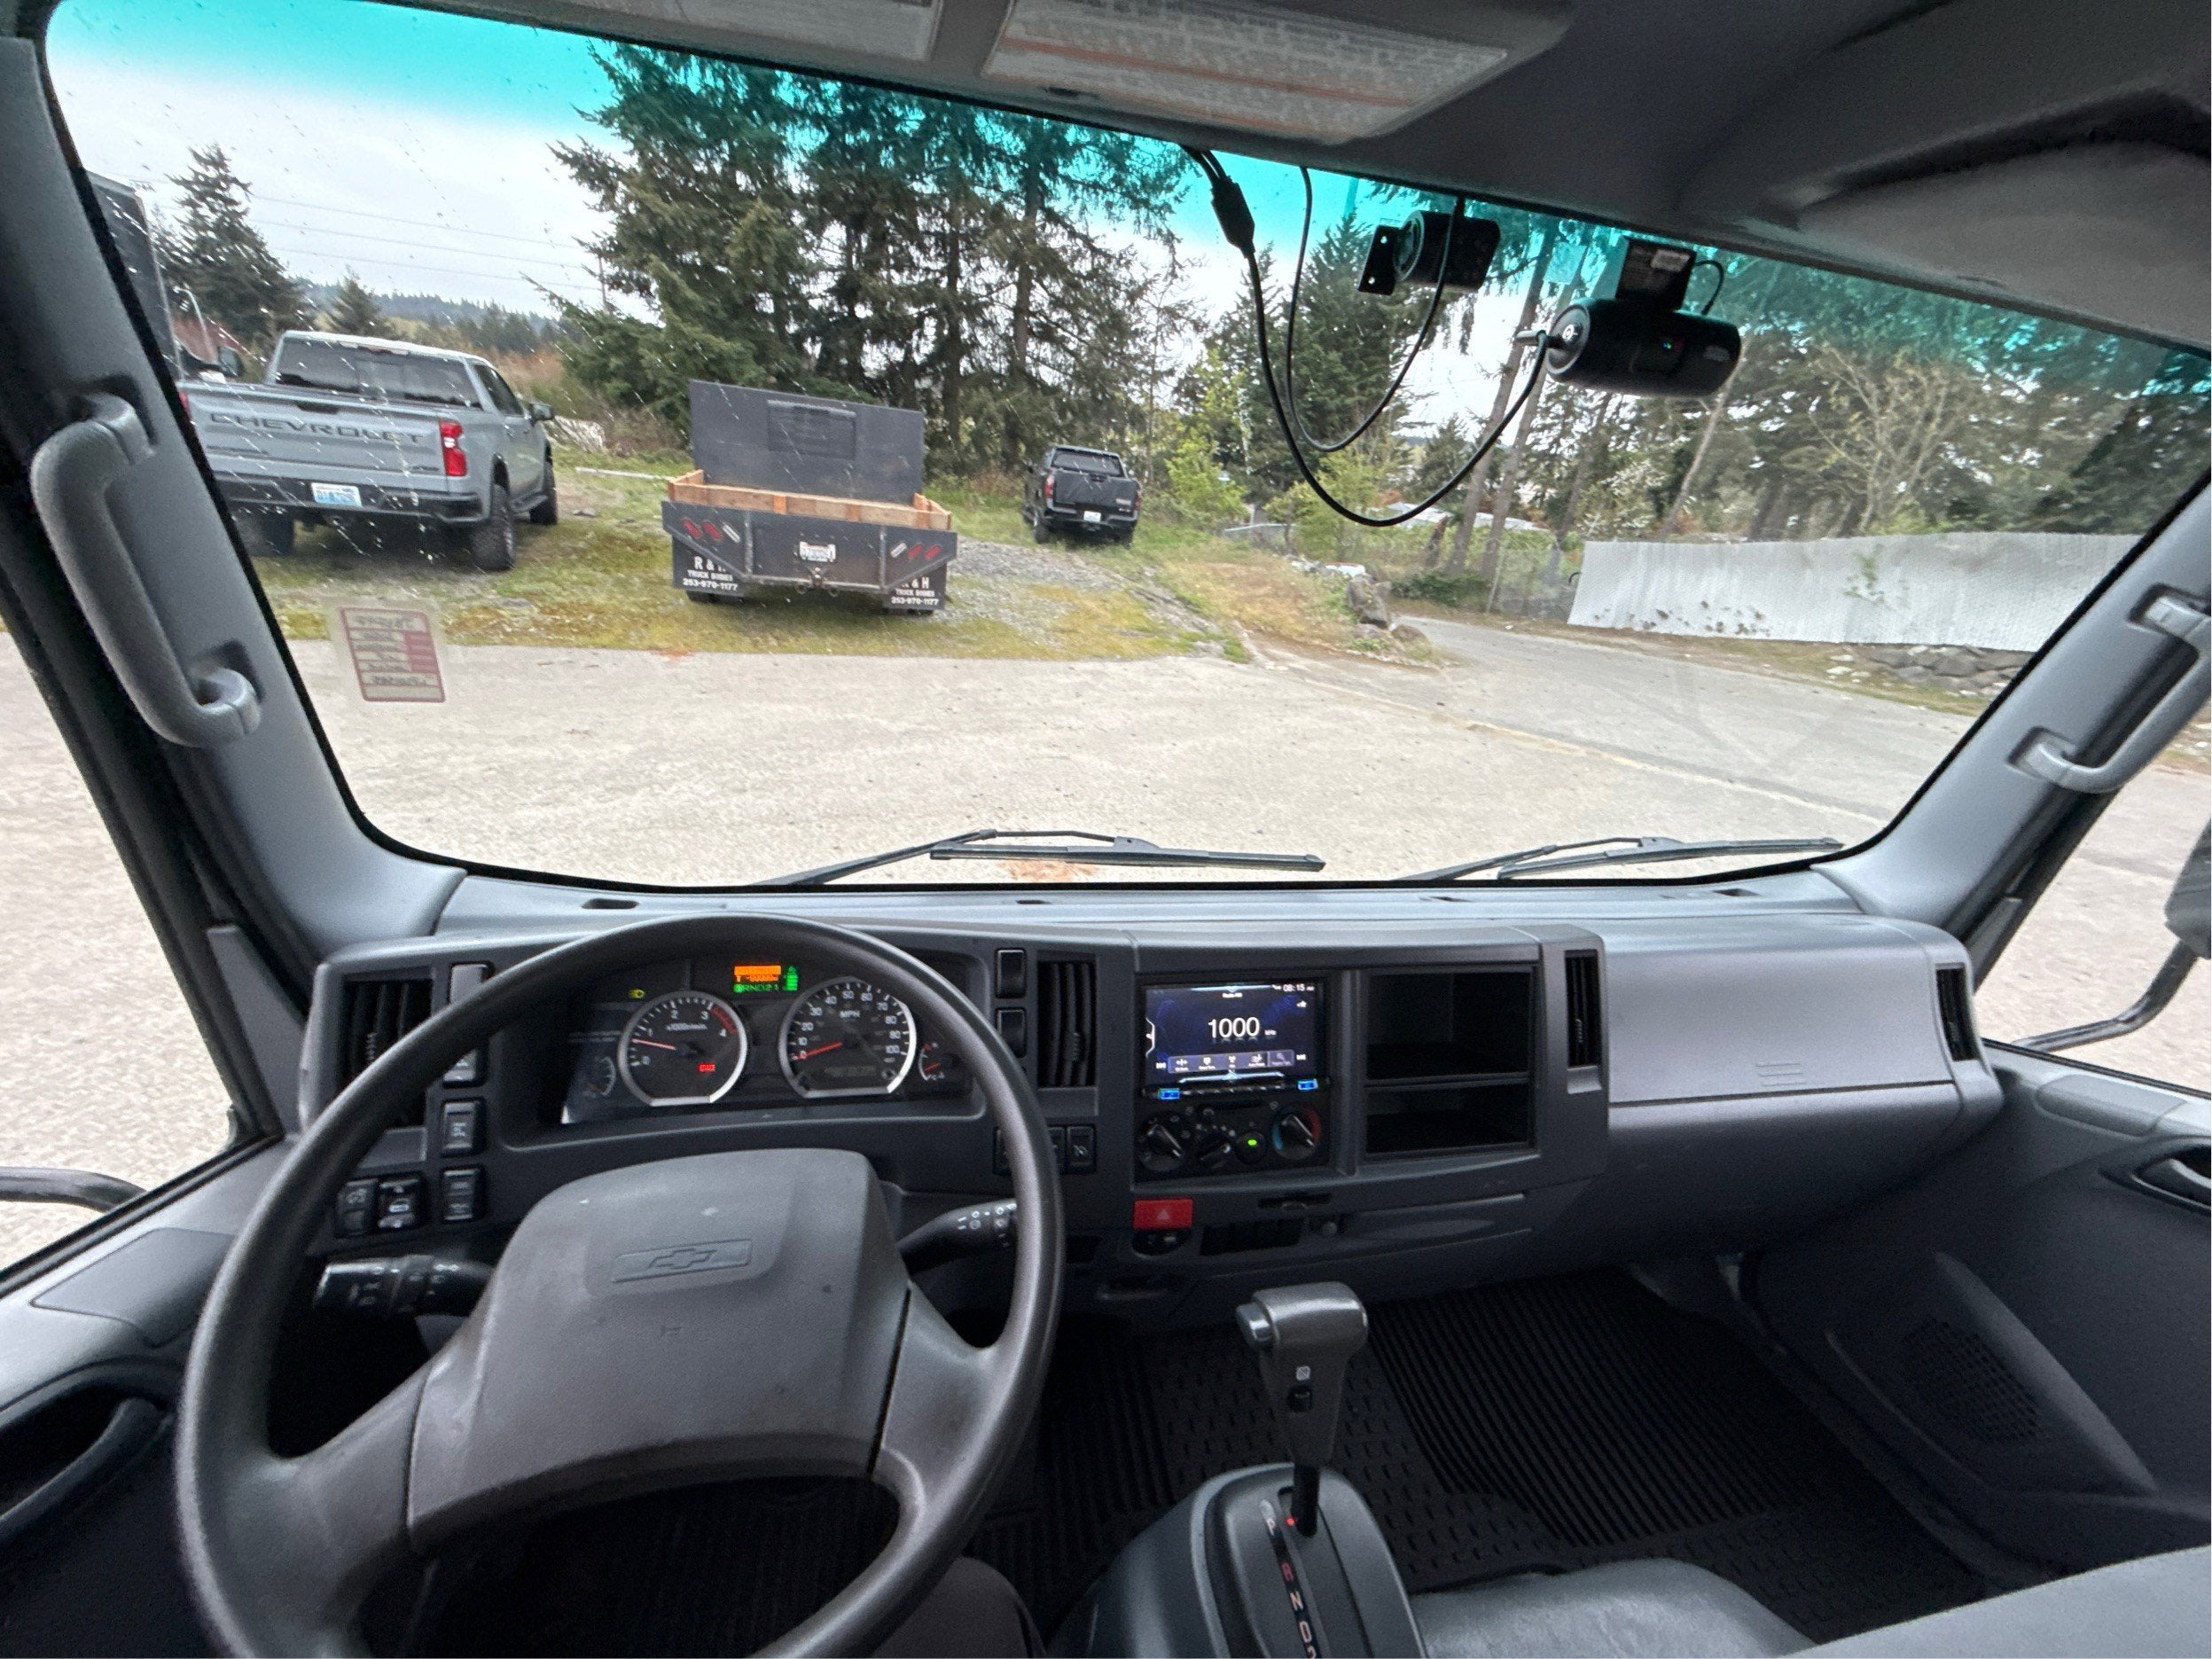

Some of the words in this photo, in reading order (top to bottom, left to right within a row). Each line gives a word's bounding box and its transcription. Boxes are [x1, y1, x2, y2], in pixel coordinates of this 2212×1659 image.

[210, 413, 424, 443] CHEVROLET
[693, 556, 703, 570] R
[921, 576, 930, 589] H
[825, 996, 838, 1005] 40
[842, 990, 855, 999] 50
[860, 992, 873, 1002] 60
[701, 1010, 709, 1021] 3
[809, 1006, 823, 1016] 30
[801, 1021, 814, 1031] 20
[1208, 1017, 1261, 1038] 1000
[1267, 1517, 1276, 1536] P
[1289, 1591, 1303, 1611] N
